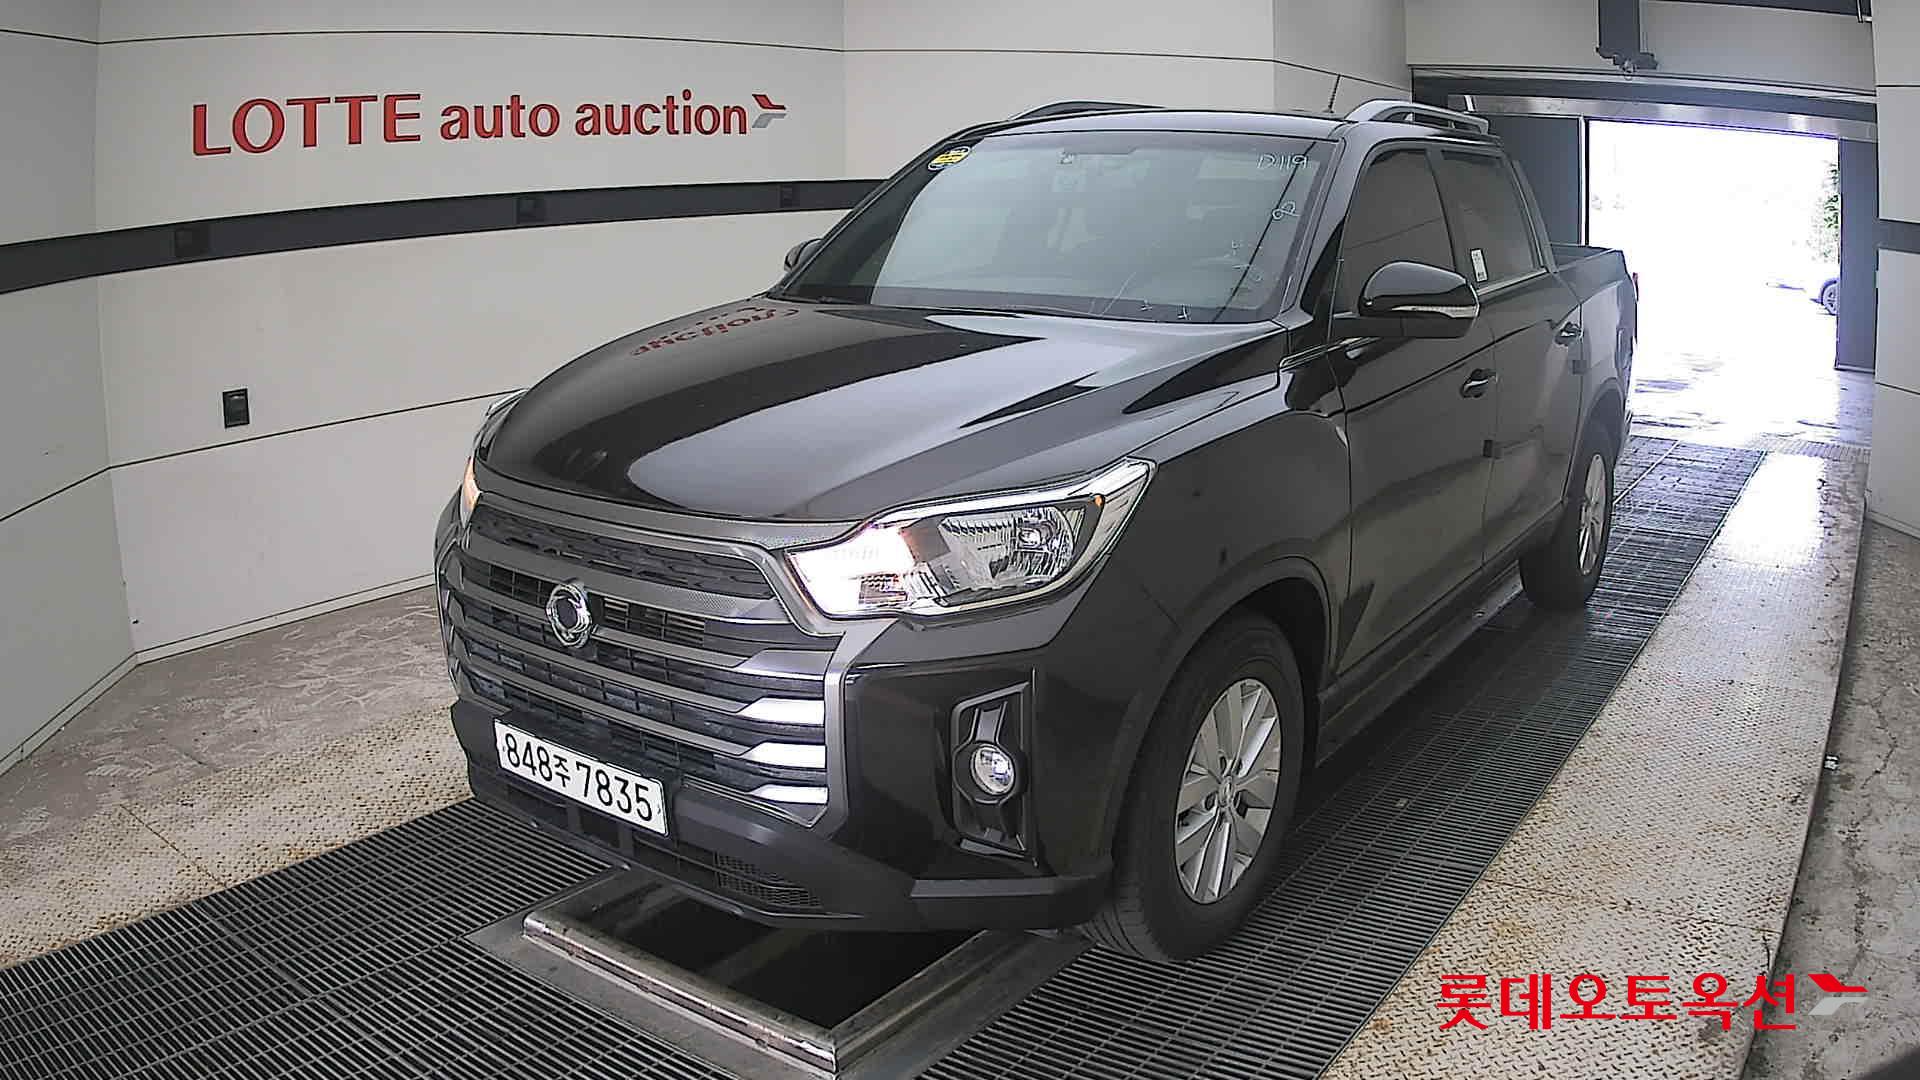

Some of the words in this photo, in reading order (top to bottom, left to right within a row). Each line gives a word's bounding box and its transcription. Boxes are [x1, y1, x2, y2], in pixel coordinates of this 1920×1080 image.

[193, 94, 421, 156] LOTTE
[440, 94, 560, 140] auto
[574, 88, 748, 136] auction
